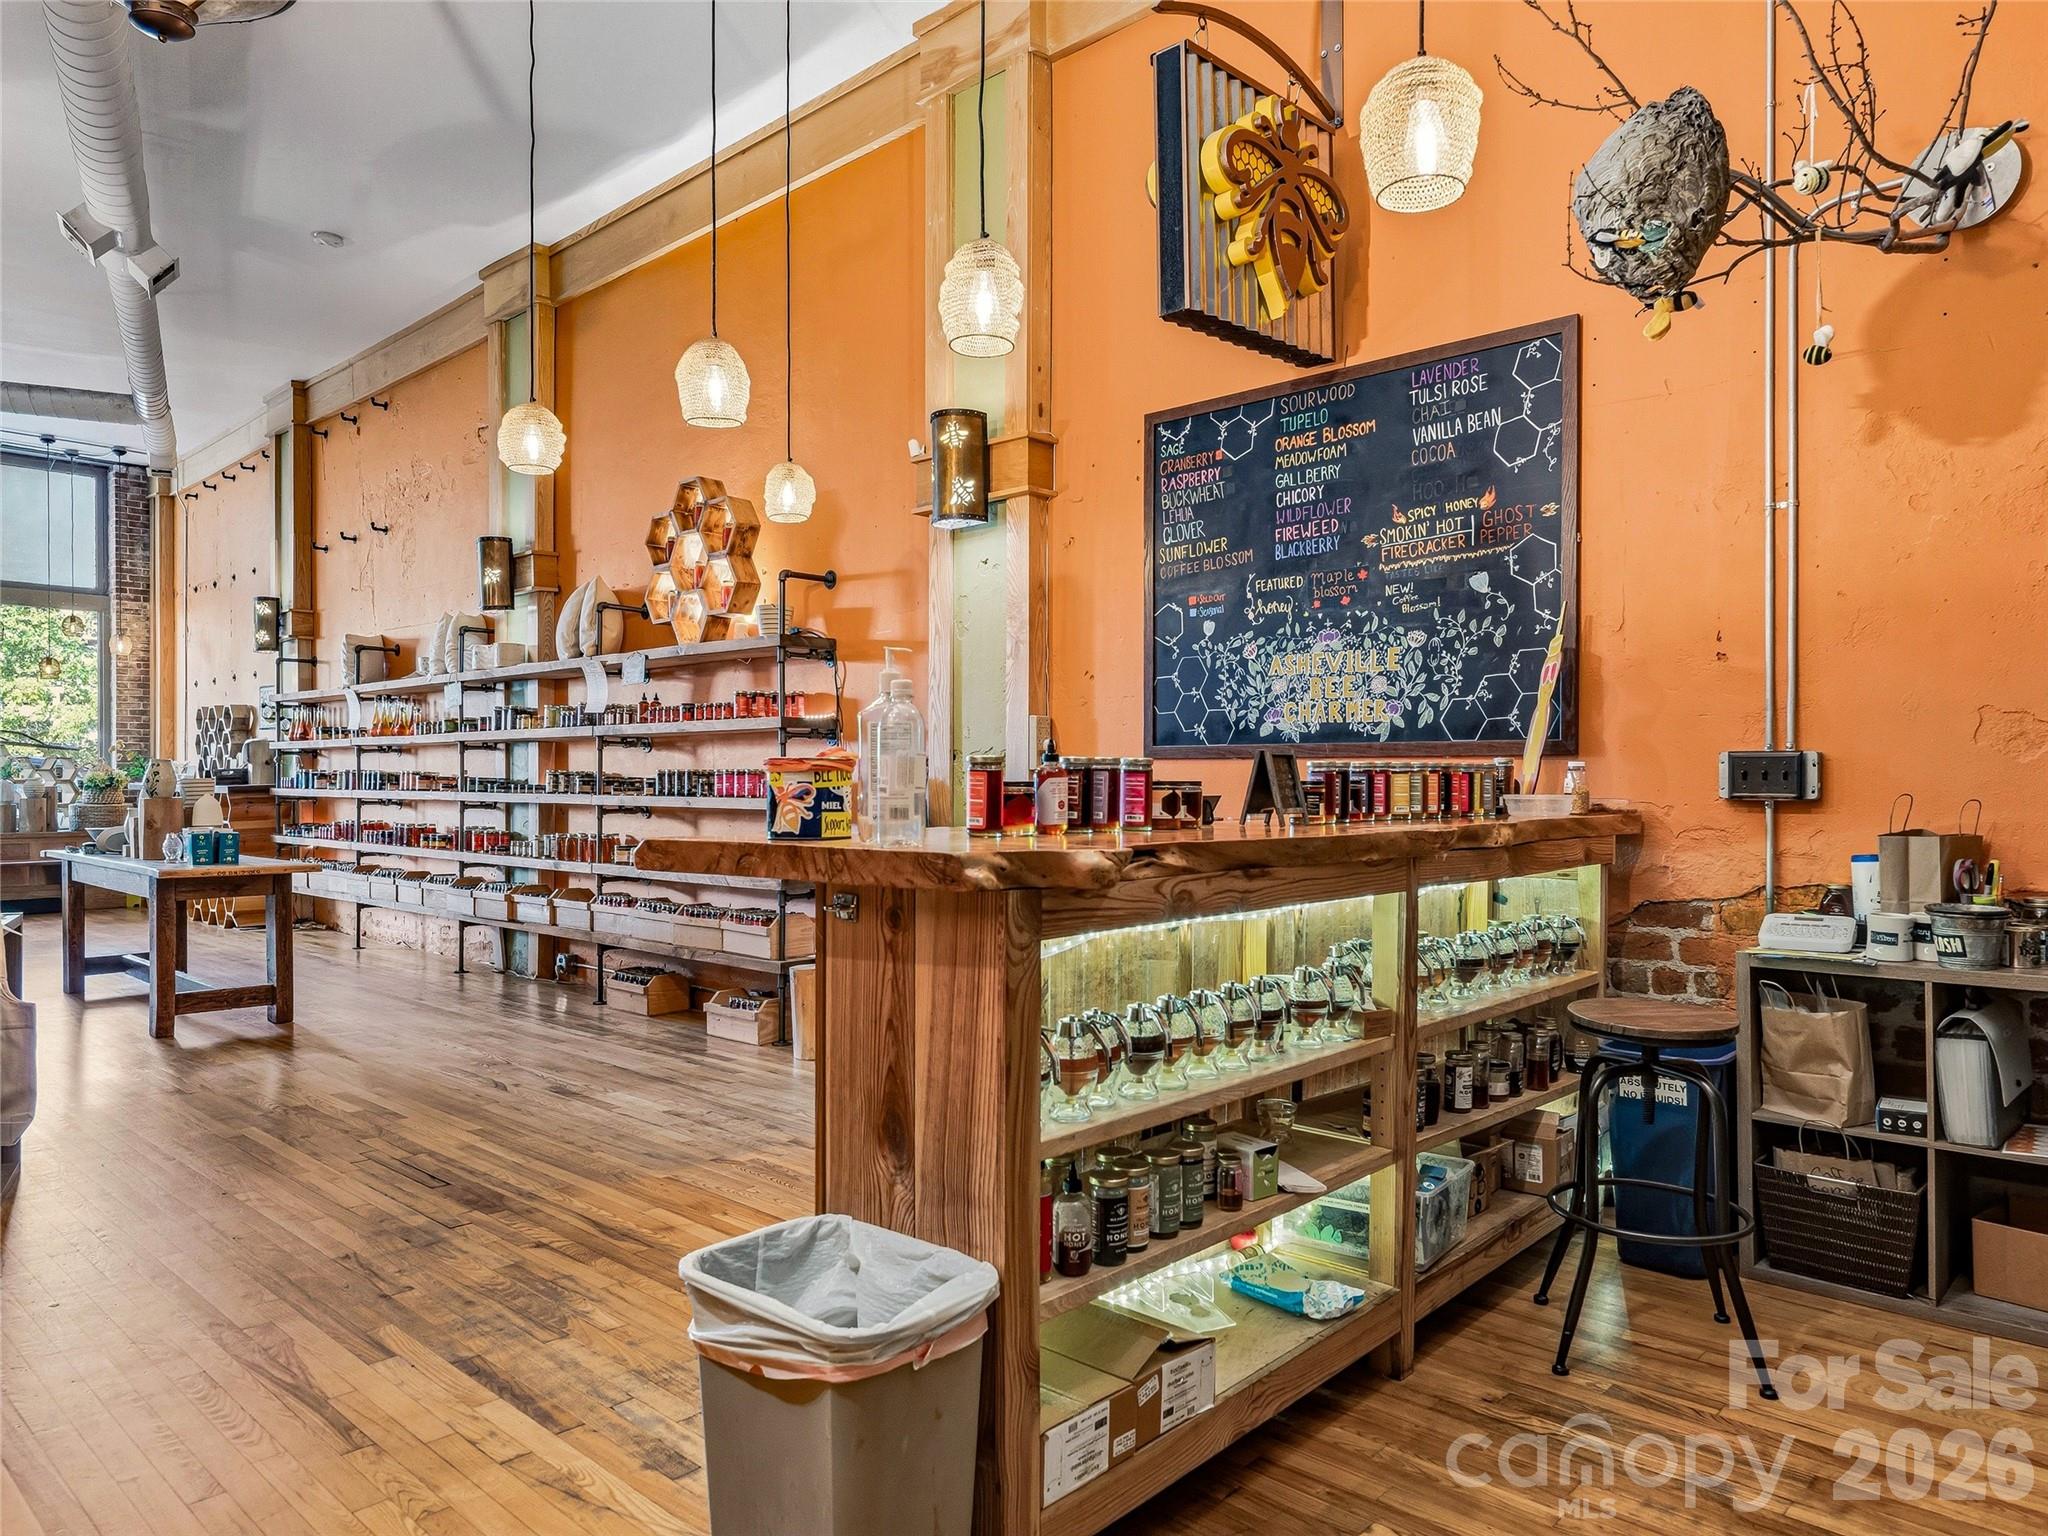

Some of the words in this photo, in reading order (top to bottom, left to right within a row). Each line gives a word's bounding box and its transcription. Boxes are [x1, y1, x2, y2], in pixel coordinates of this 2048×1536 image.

[1412, 358, 1479, 388] LAVENDER
[1280, 383, 1355, 415] SOURWOOD
[1410, 384, 1447, 406] TULSI
[1452, 373, 1488, 396] ROSE
[1280, 408, 1328, 433] TUPELO
[1412, 401, 1452, 423] CHAI
[1275, 431, 1317, 453] ORANGE
[1322, 419, 1376, 444] BLOSSOM
[1413, 415, 1463, 446] VANILLA
[1468, 407, 1501, 434] BEAN
[1160, 443, 1185, 458] SAGE
[1275, 444, 1347, 470] MEADOWFOAM
[1411, 442, 1456, 466] COCOA
[1160, 451, 1215, 476] CRANBERRY
[1161, 467, 1221, 493] RASPBERRY
[1276, 464, 1341, 489] GALLBERRY
[1161, 481, 1225, 510] BUCKWHEAT
[1276, 485, 1325, 508] CHICORY
[1163, 506, 1194, 525] LEHUA
[1276, 497, 1352, 525] WILDFLOWER
[1407, 505, 1436, 523] SPICY
[1445, 498, 1478, 512] HONEY
[1482, 505, 1536, 528] GHOST
[1163, 520, 1206, 546] CLOVER
[1275, 518, 1339, 542] FIREWEED
[1379, 522, 1430, 545] SMOKIN'
[1436, 517, 1464, 537] HOT
[1480, 525, 1533, 545] PEPPER
[1160, 537, 1228, 564] SUNFLOWER
[1275, 536, 1341, 561] BLACKBERRY
[1381, 533, 1466, 562] FIRECRACKER
[1160, 559, 1200, 580] COFFEE
[1203, 549, 1254, 575] BLOSSOM
[1255, 575, 1304, 593] FEATURED
[1385, 582, 1414, 596] NEW!
[1270, 648, 1402, 675] ASHEVILLE
[1309, 677, 1359, 699] BEE
[1283, 698, 1391, 723] CHARMER
[1620, 1076, 1687, 1093] ABSUTELY
[1064, 1232, 1085, 1242] HOT
